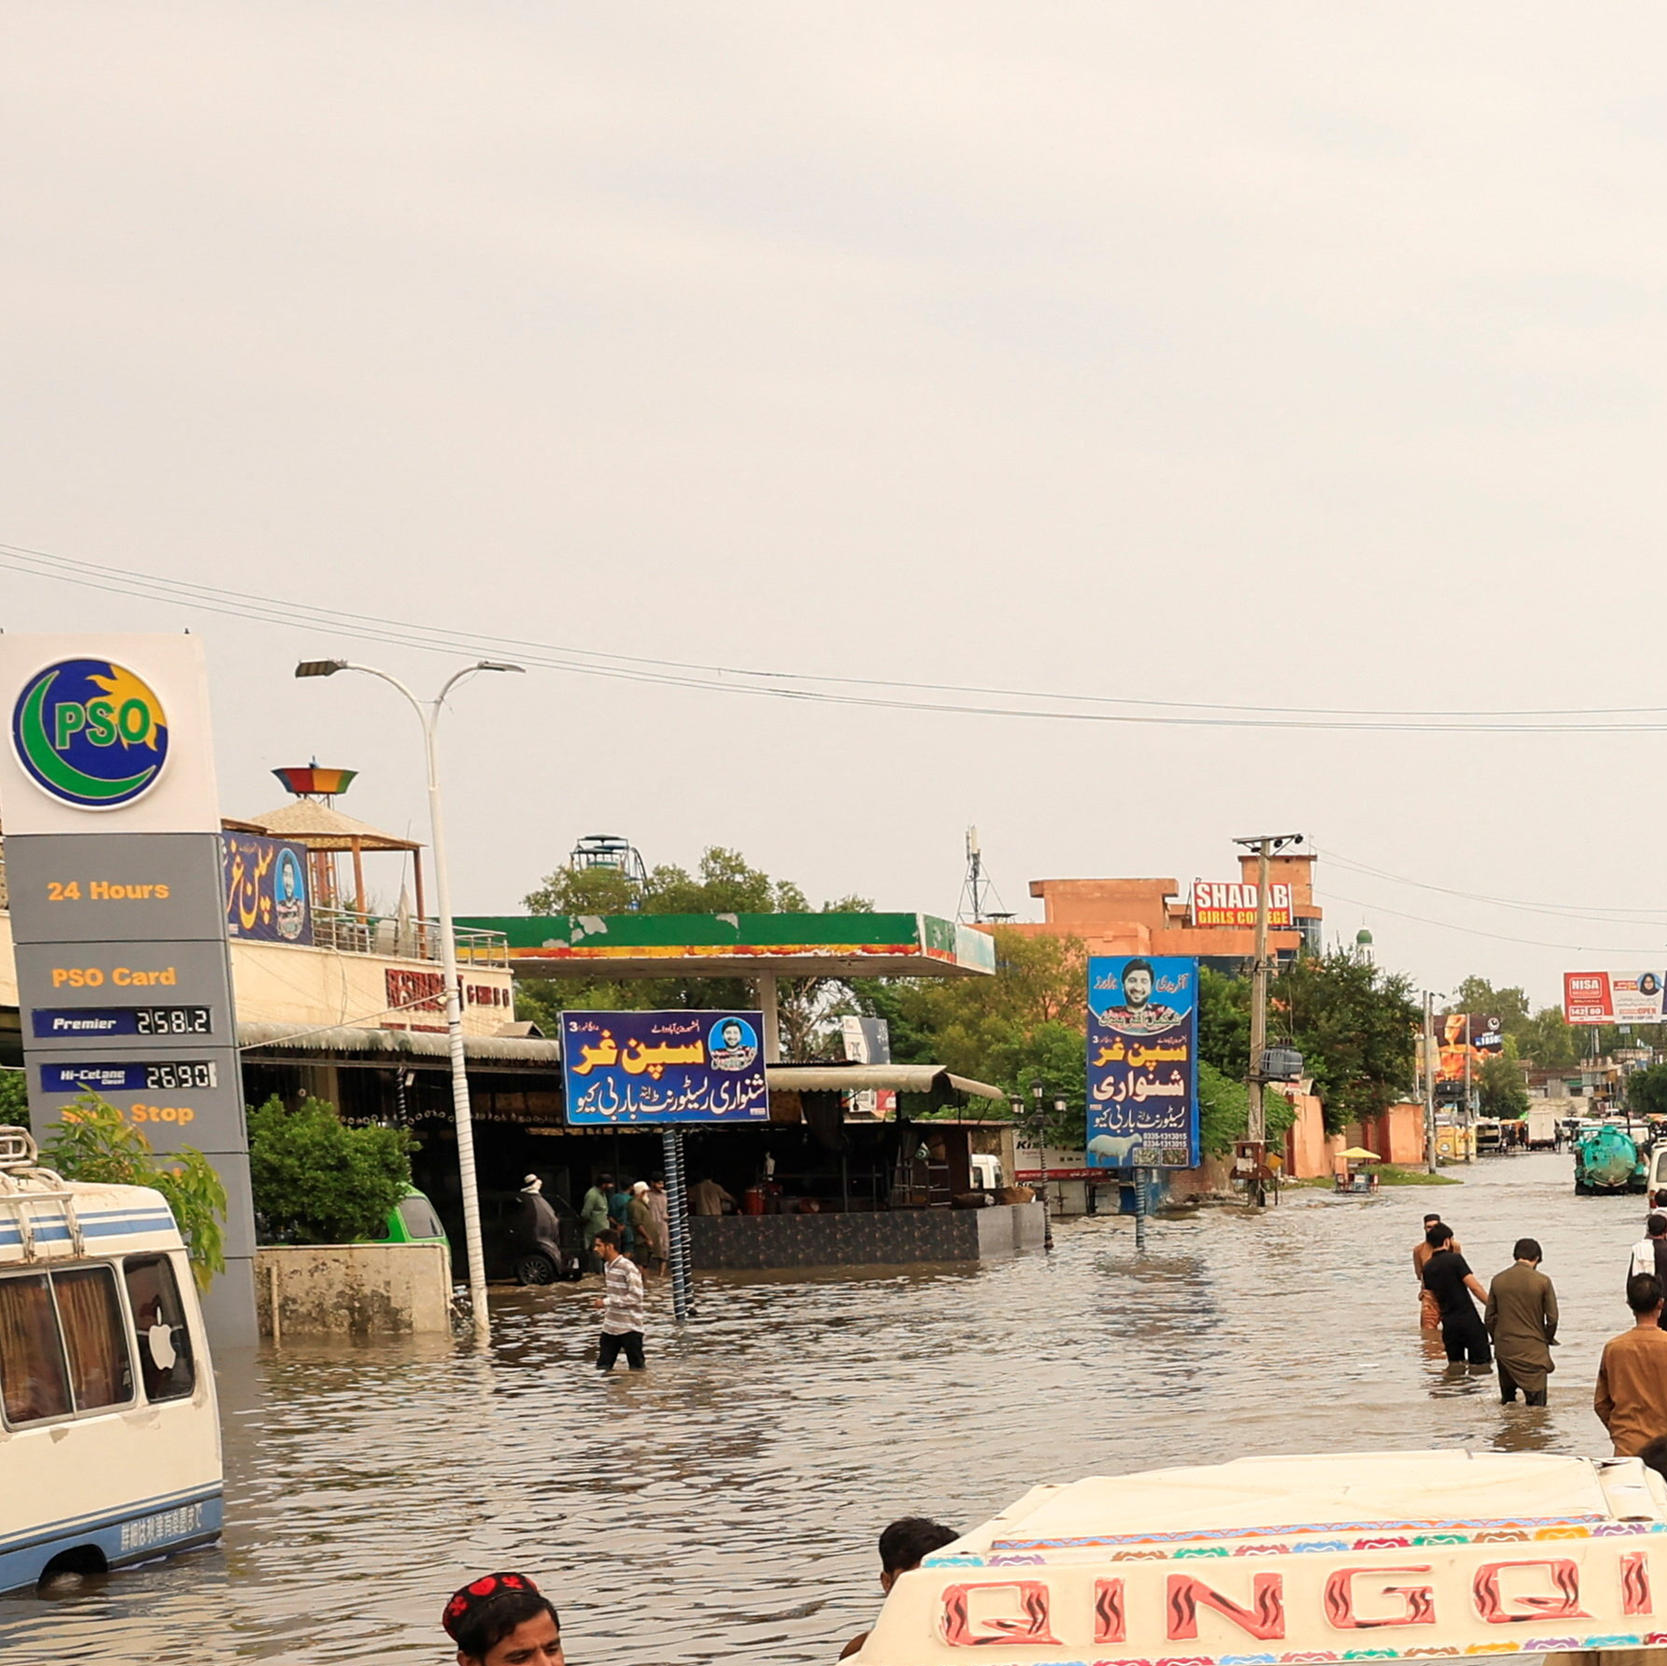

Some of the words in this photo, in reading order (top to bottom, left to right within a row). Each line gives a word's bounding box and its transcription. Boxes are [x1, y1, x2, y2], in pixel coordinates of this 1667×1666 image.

[54, 698, 151, 750] PSO
[48, 882, 81, 901] 24
[89, 881, 170, 901] Hours
[1198, 910, 1234, 924] GIRLS
[52, 968, 104, 988] PSO
[111, 967, 177, 987] Card
[53, 1017, 116, 1030] Premier
[137, 1010, 207, 1035] 258.2
[60, 1069, 126, 1081] Hi-Cetane
[131, 1103, 195, 1125] Stop
[940, 1550, 1655, 1649] QINGQI
